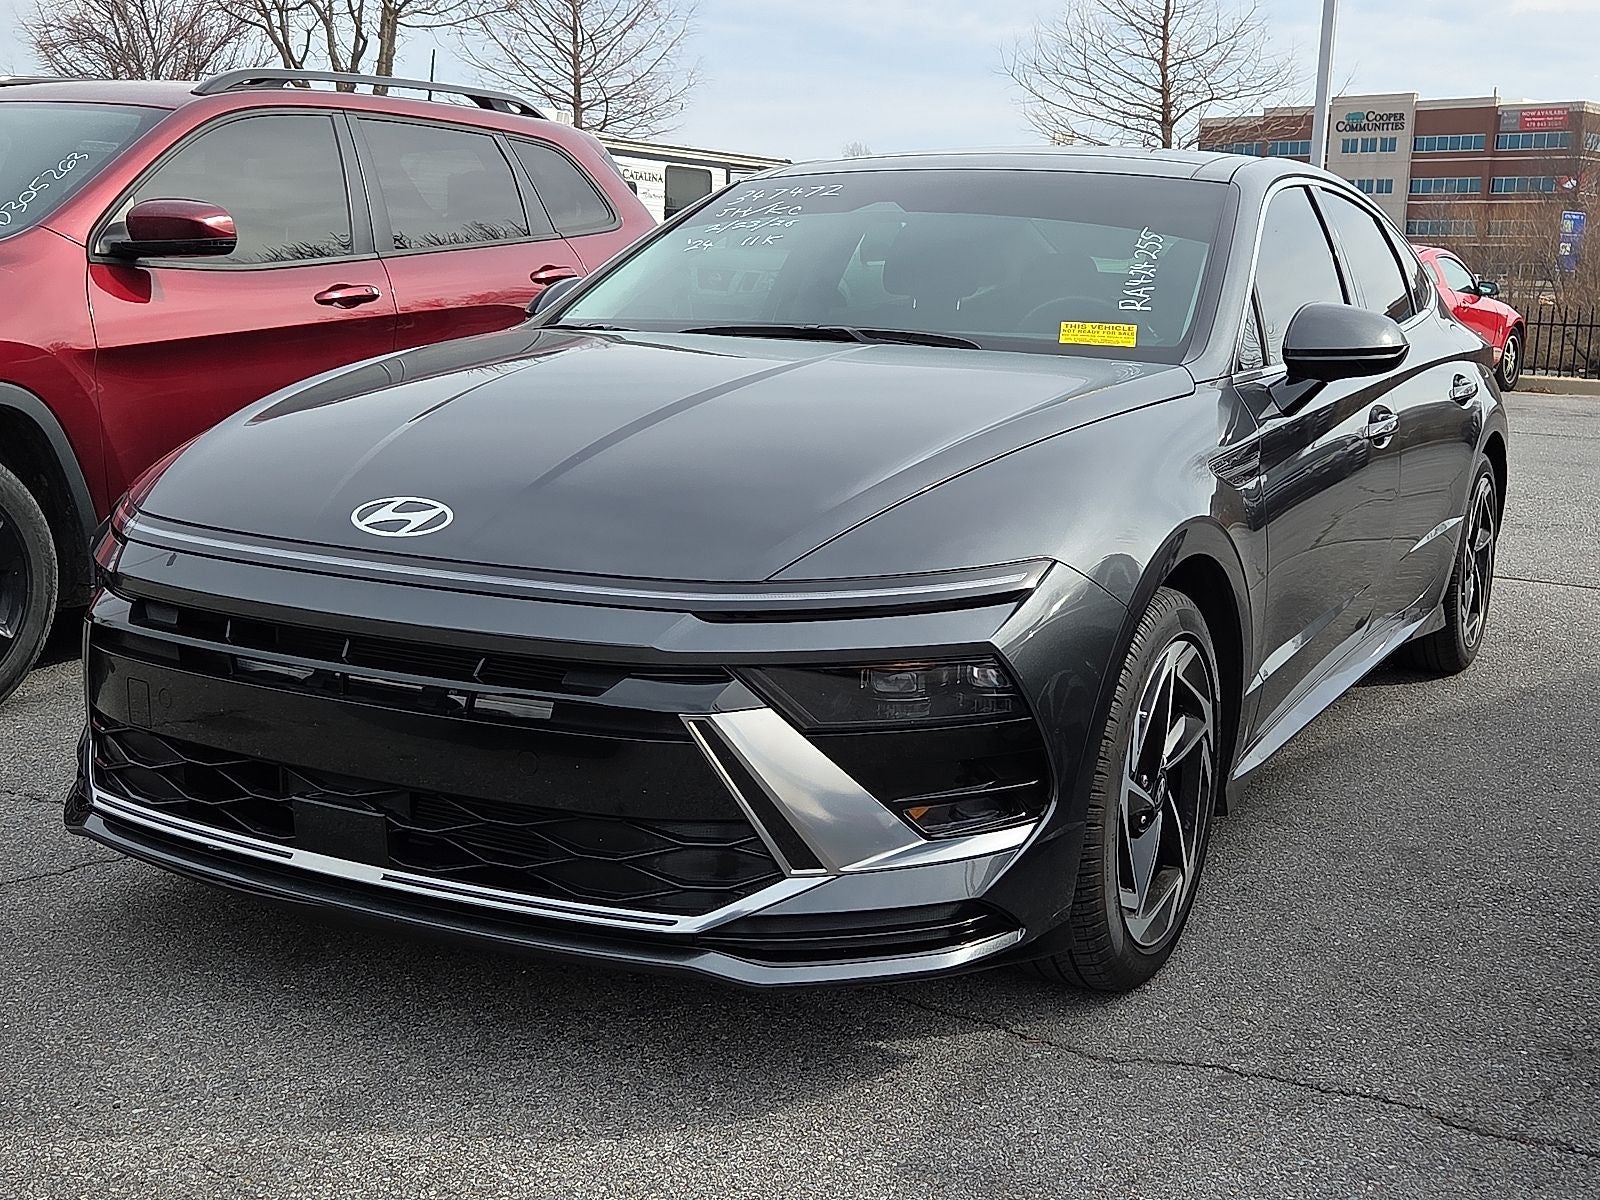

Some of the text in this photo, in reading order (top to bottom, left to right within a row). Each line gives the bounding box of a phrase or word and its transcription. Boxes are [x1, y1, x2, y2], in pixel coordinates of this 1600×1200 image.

[1366, 110, 1405, 122] COOPER
[1335, 121, 1406, 133] COMMUNITIES
[622, 168, 664, 183] CATALINA
[1091, 324, 1135, 332] VEHICLE
